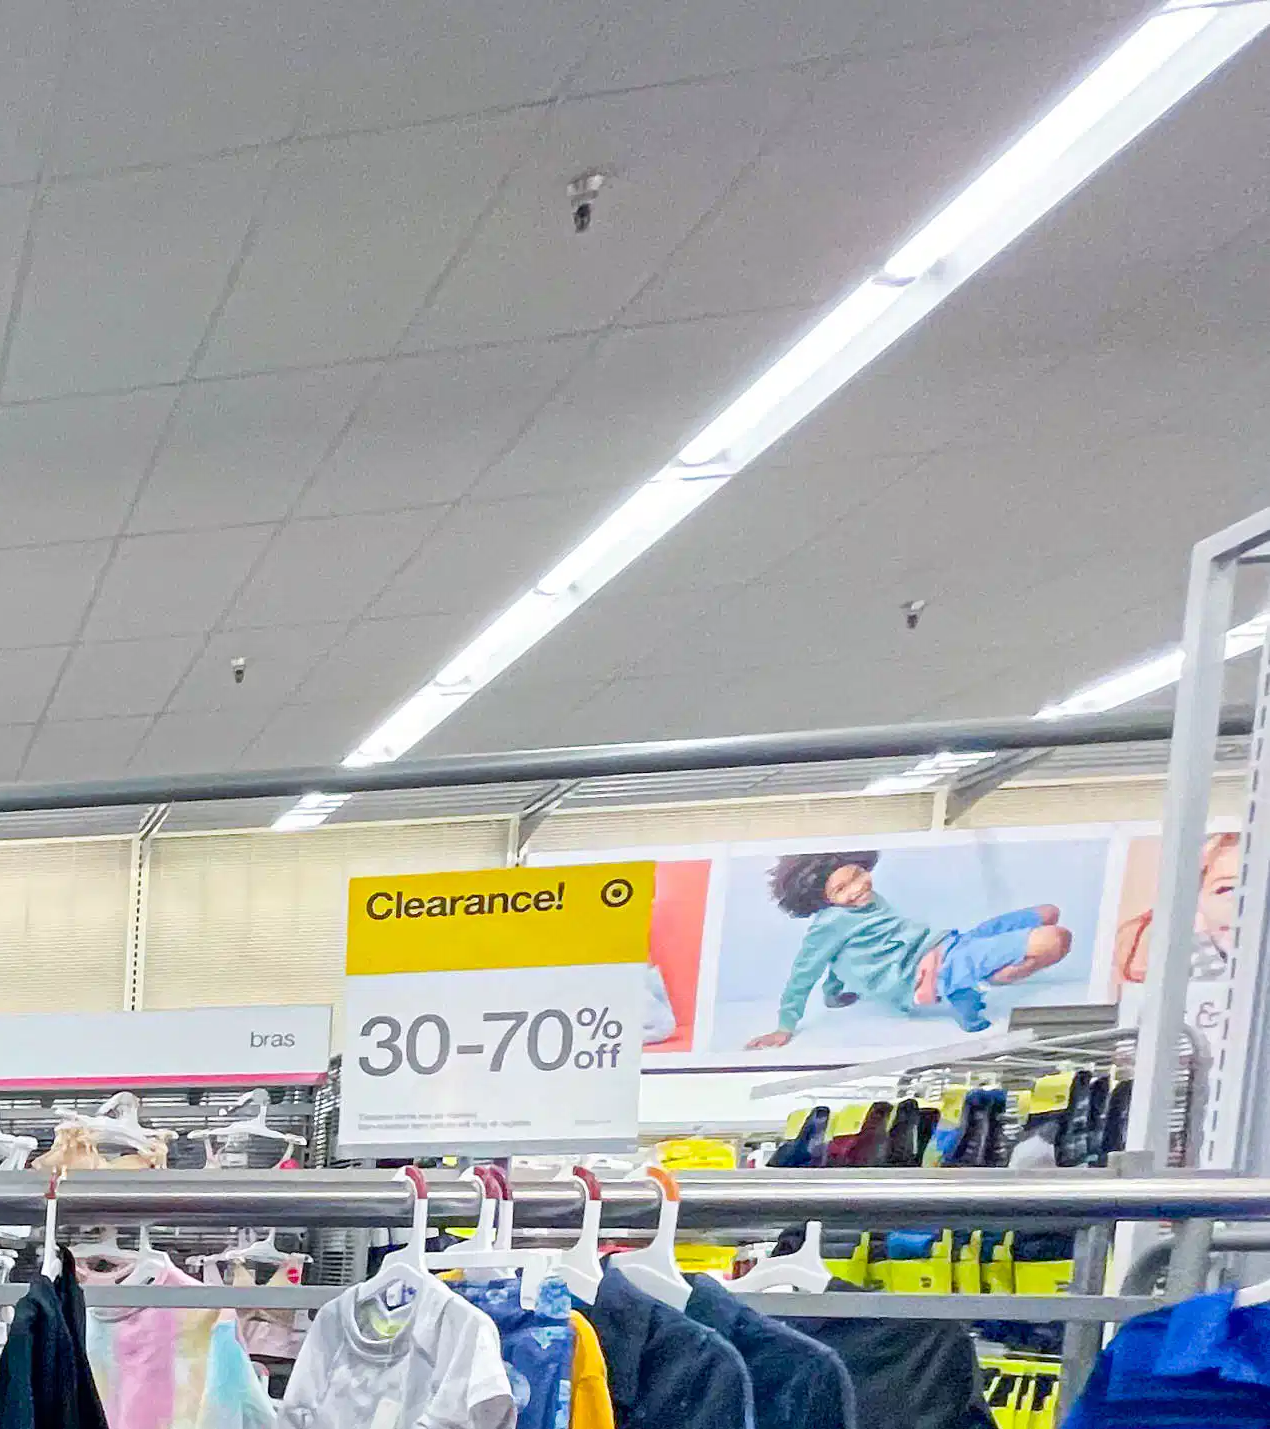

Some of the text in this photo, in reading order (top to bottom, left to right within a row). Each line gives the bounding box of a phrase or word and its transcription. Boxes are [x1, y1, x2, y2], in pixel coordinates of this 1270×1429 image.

[365, 881, 566, 921] Clearance!
[249, 1031, 295, 1048] bras
[573, 1043, 621, 1070] off
